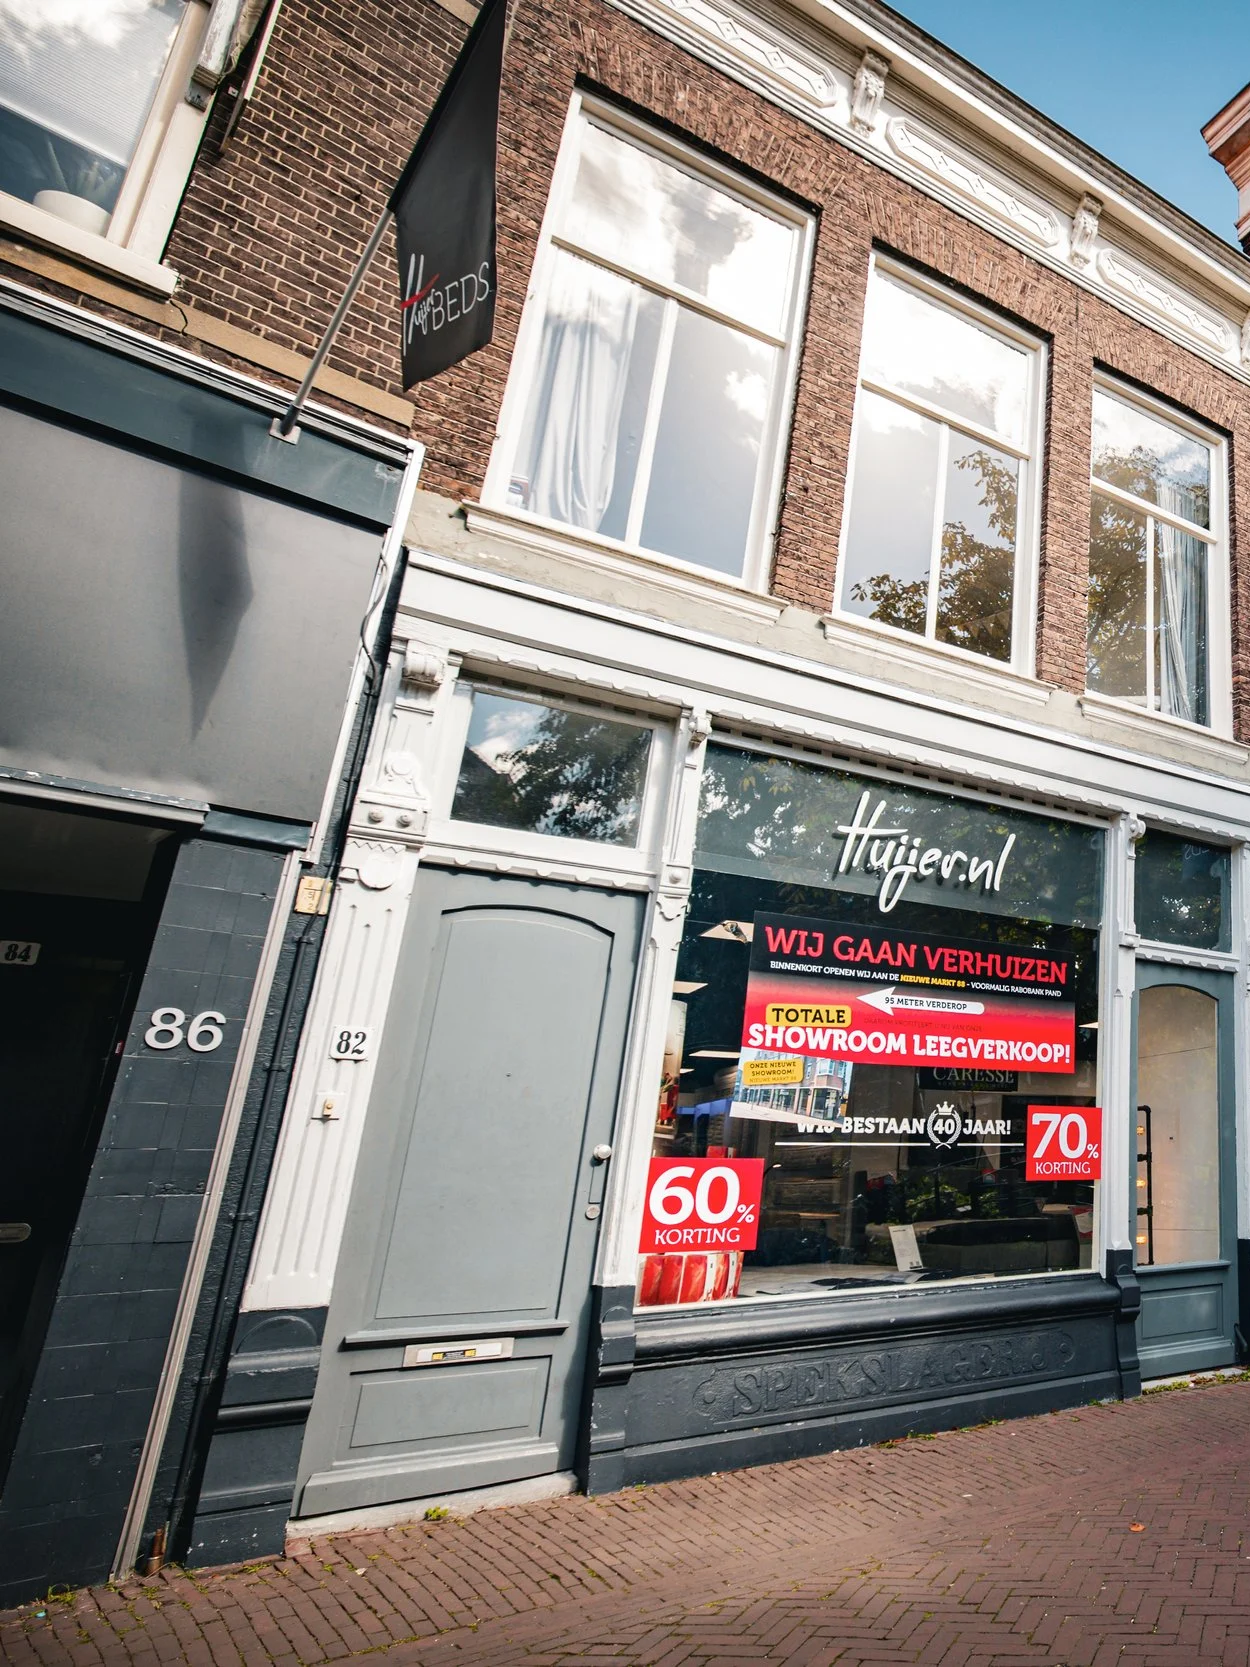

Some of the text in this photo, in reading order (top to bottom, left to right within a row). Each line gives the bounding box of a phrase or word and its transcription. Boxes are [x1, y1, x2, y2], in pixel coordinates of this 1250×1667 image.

[432, 261, 490, 331] BEDS
[837, 790, 1016, 913] Huijer.nl
[4, 943, 32, 962] 84
[765, 926, 1068, 985] WIJ GAAN VERHUIZEN
[770, 960, 823, 974] BINNENKORT
[823, 966, 855, 977] OPENEN
[856, 970, 871, 979] WIJ
[871, 972, 888, 981] AAN
[889, 973, 899, 982] DE
[900, 974, 932, 984] NIEUWE
[931, 977, 956, 988] MARKT
[970, 981, 1010, 993] VOORMALIG
[1010, 985, 1045, 997] RABOBANK
[1044, 989, 1062, 998] PAND
[772, 1008, 846, 1024] TOTALE
[885, 996, 967, 1011] 95 METER VERDEROP
[144, 1006, 227, 1052] 86
[336, 1030, 367, 1055] 82
[748, 1023, 1070, 1064] SHOWROOM LEEGVERKOOP!
[933, 1067, 1014, 1083] CARESSE
[841, 1116, 926, 1135] BESTAAN
[933, 1119, 956, 1135] 40
[962, 1118, 1011, 1135] JAAR!
[1031, 1112, 1099, 1160] 70%
[1035, 1161, 1091, 1175] KORTING
[649, 1165, 756, 1226] 60%
[655, 1227, 740, 1245] KORTING
